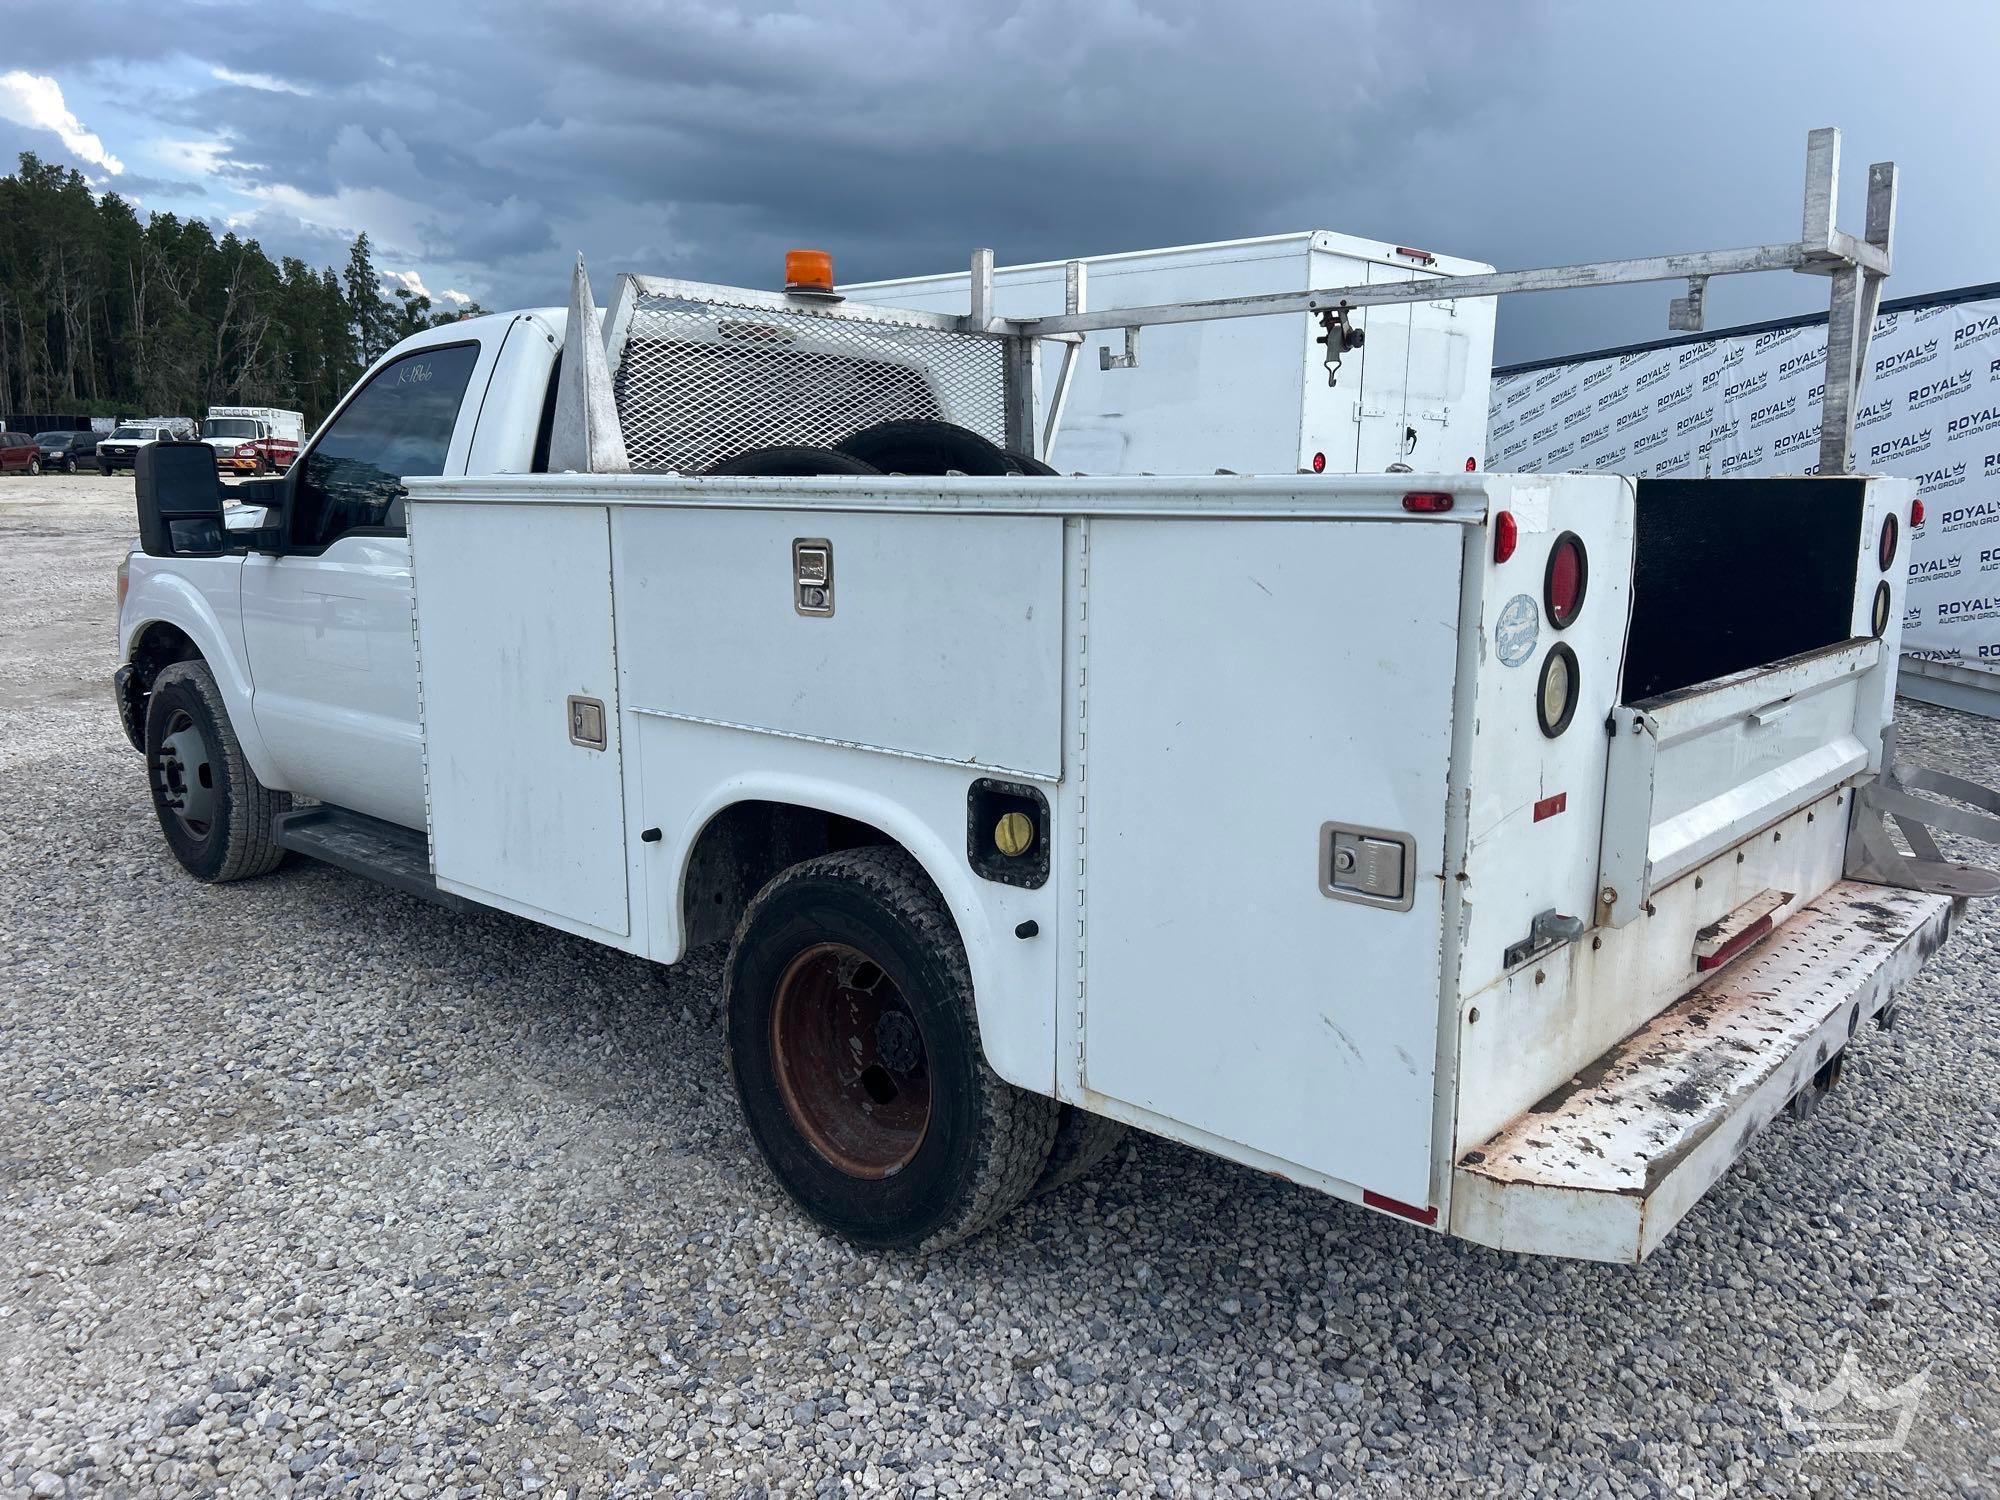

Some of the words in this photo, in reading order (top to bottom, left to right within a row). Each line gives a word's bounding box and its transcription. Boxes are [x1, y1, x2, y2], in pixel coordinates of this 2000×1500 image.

[1954, 315, 2000, 342] ROYA
[1954, 331, 1991, 351] AUCTION
[1679, 343, 1709, 364] ROYAL
[1779, 350, 1817, 374] ROYAL
[1875, 346, 1924, 373] ROYAL
[1636, 367, 1662, 386] ROYAL
[1779, 366, 1805, 382] AUCTION
[1875, 364, 1909, 382] AUCTION
[1909, 352, 1938, 369] GROUP
[1724, 376, 1758, 397] ROYAL
[1908, 376, 1959, 403] ROYAL
[1657, 388, 1686, 408] ROYAL
[1908, 394, 1944, 412] AUCTION
[1944, 383, 1972, 399] GROUP
[1616, 409, 1642, 427] ROYAL
[1677, 411, 1706, 431] ROYAL
[1750, 401, 1786, 423] ROYAL
[1750, 416, 1775, 430] AUCTION
[1775, 407, 1796, 421] GROUP
[1867, 412, 1893, 425] GROUP
[1947, 407, 2000, 434] ROYAL
[1634, 431, 1661, 449] ROYAL
[1774, 428, 1812, 450] ROYAL
[1947, 425, 1985, 442] AUCTION
[1774, 444, 1800, 458] AUCTION
[1871, 434, 1919, 457] ROYAL
[1871, 450, 1905, 466] AUCTION
[1905, 442, 1931, 456] GROUP
[1656, 454, 1684, 472] ROYAL
[1721, 450, 1754, 469] ROYAL
[1937, 476, 1966, 490] GROUP
[1942, 502, 1997, 525] ROYAL
[1942, 519, 1979, 534] AUCTION
[1909, 558, 1948, 575] OYAL
[1932, 569, 1962, 581] GROUP
[1938, 597, 1993, 616] ROYAL
[1938, 614, 1977, 625] AUCTION
